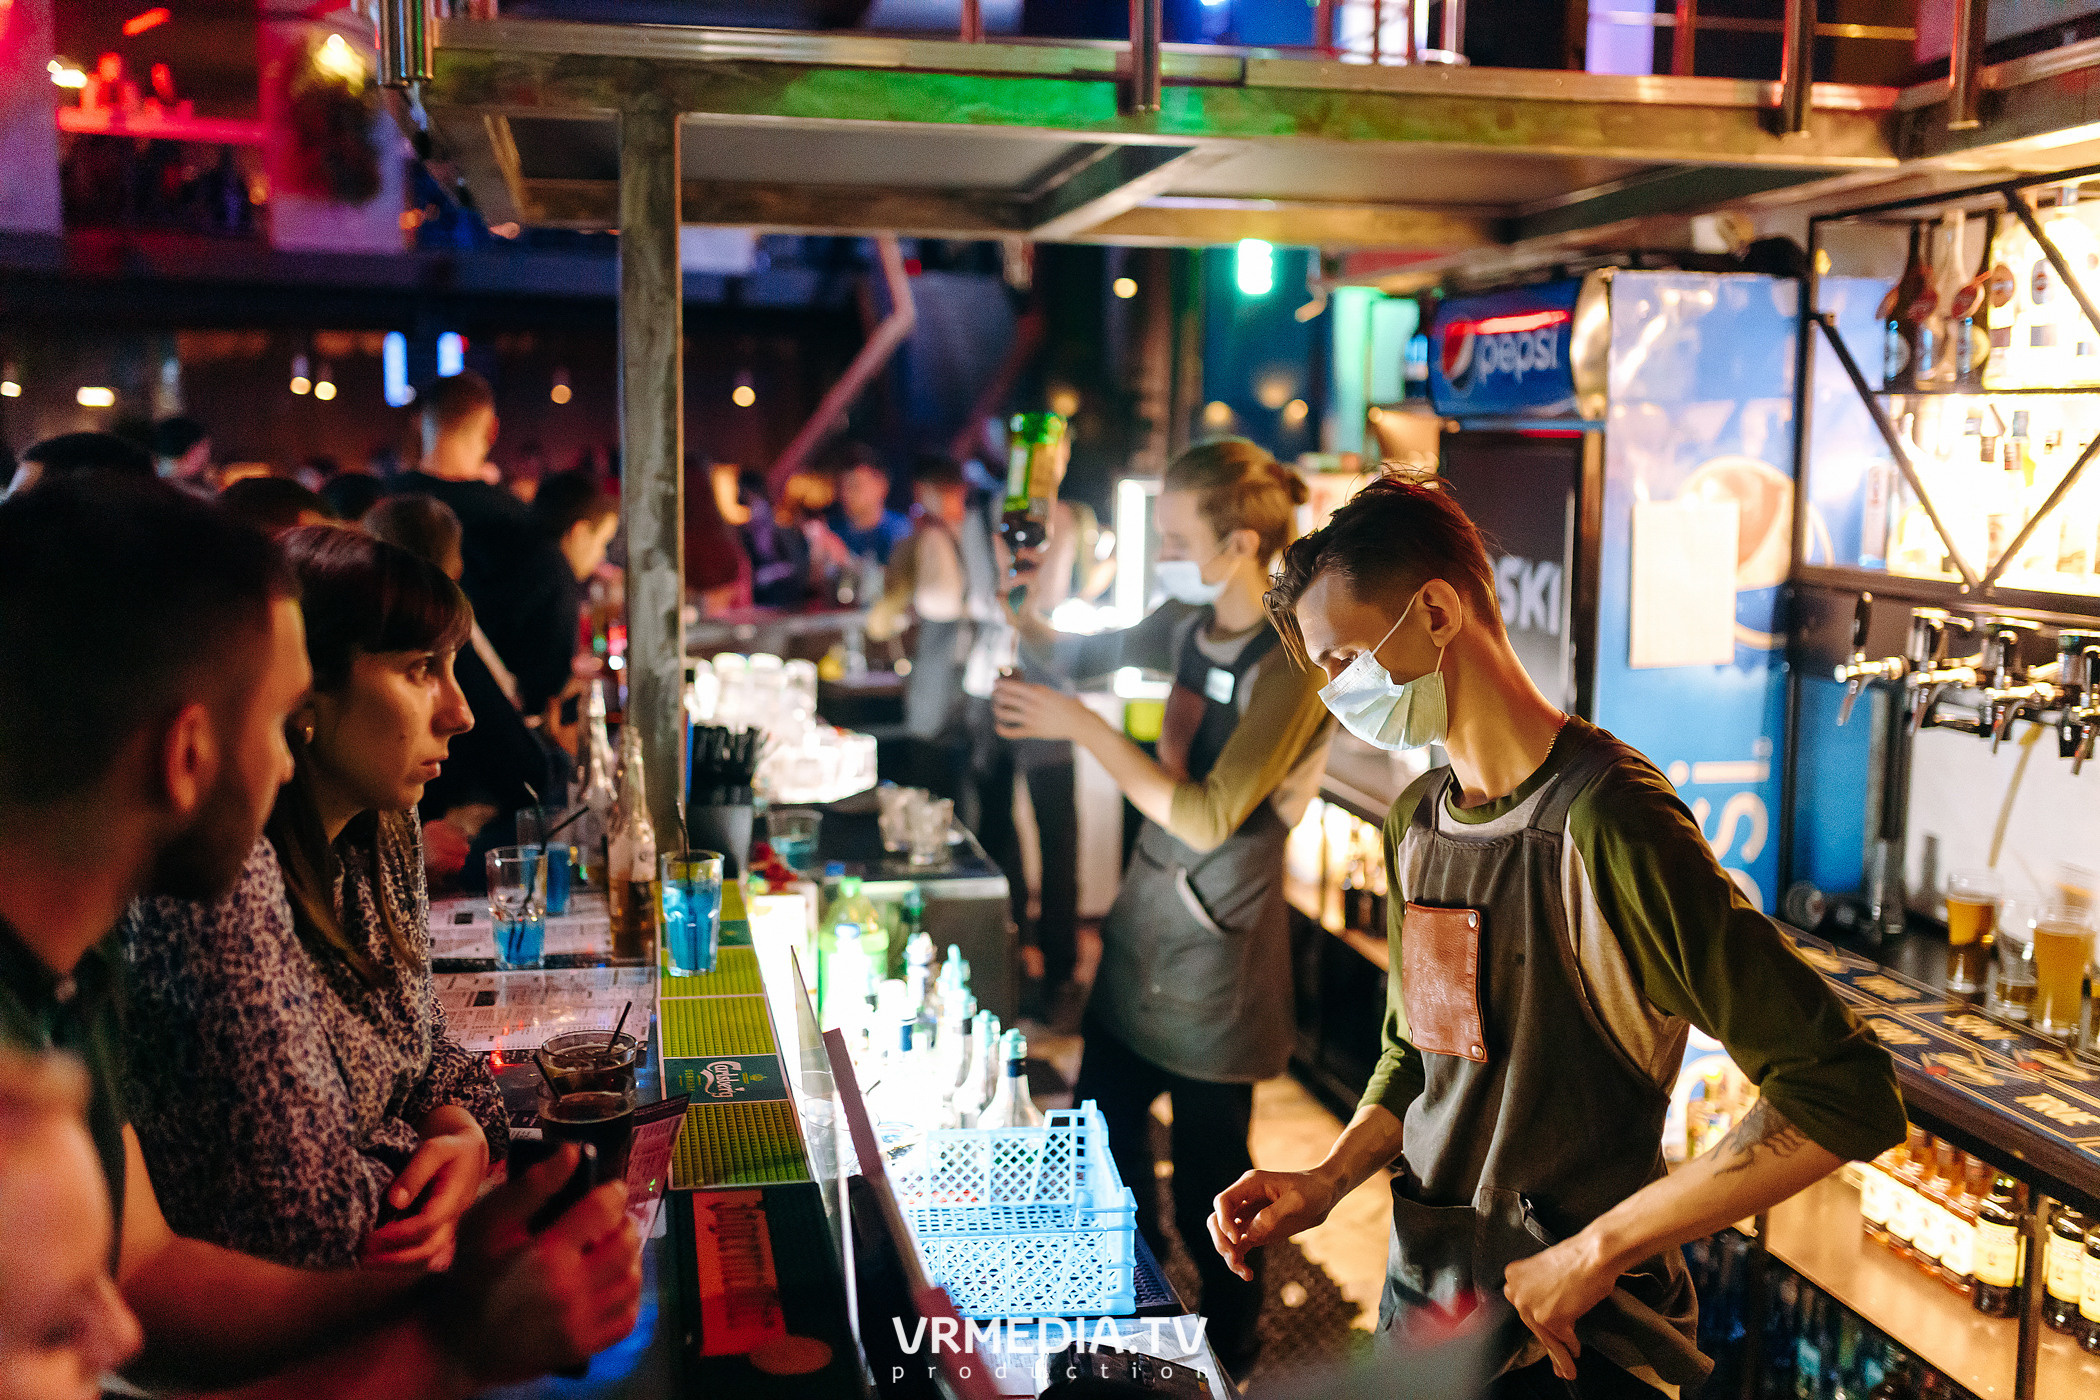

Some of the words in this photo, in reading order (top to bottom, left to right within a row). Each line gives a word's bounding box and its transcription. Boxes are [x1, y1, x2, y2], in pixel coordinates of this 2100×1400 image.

[1476, 325, 1559, 385] pepsi
[1487, 556, 1561, 636] SKI
[700, 1061, 745, 1098] Carlsberg
